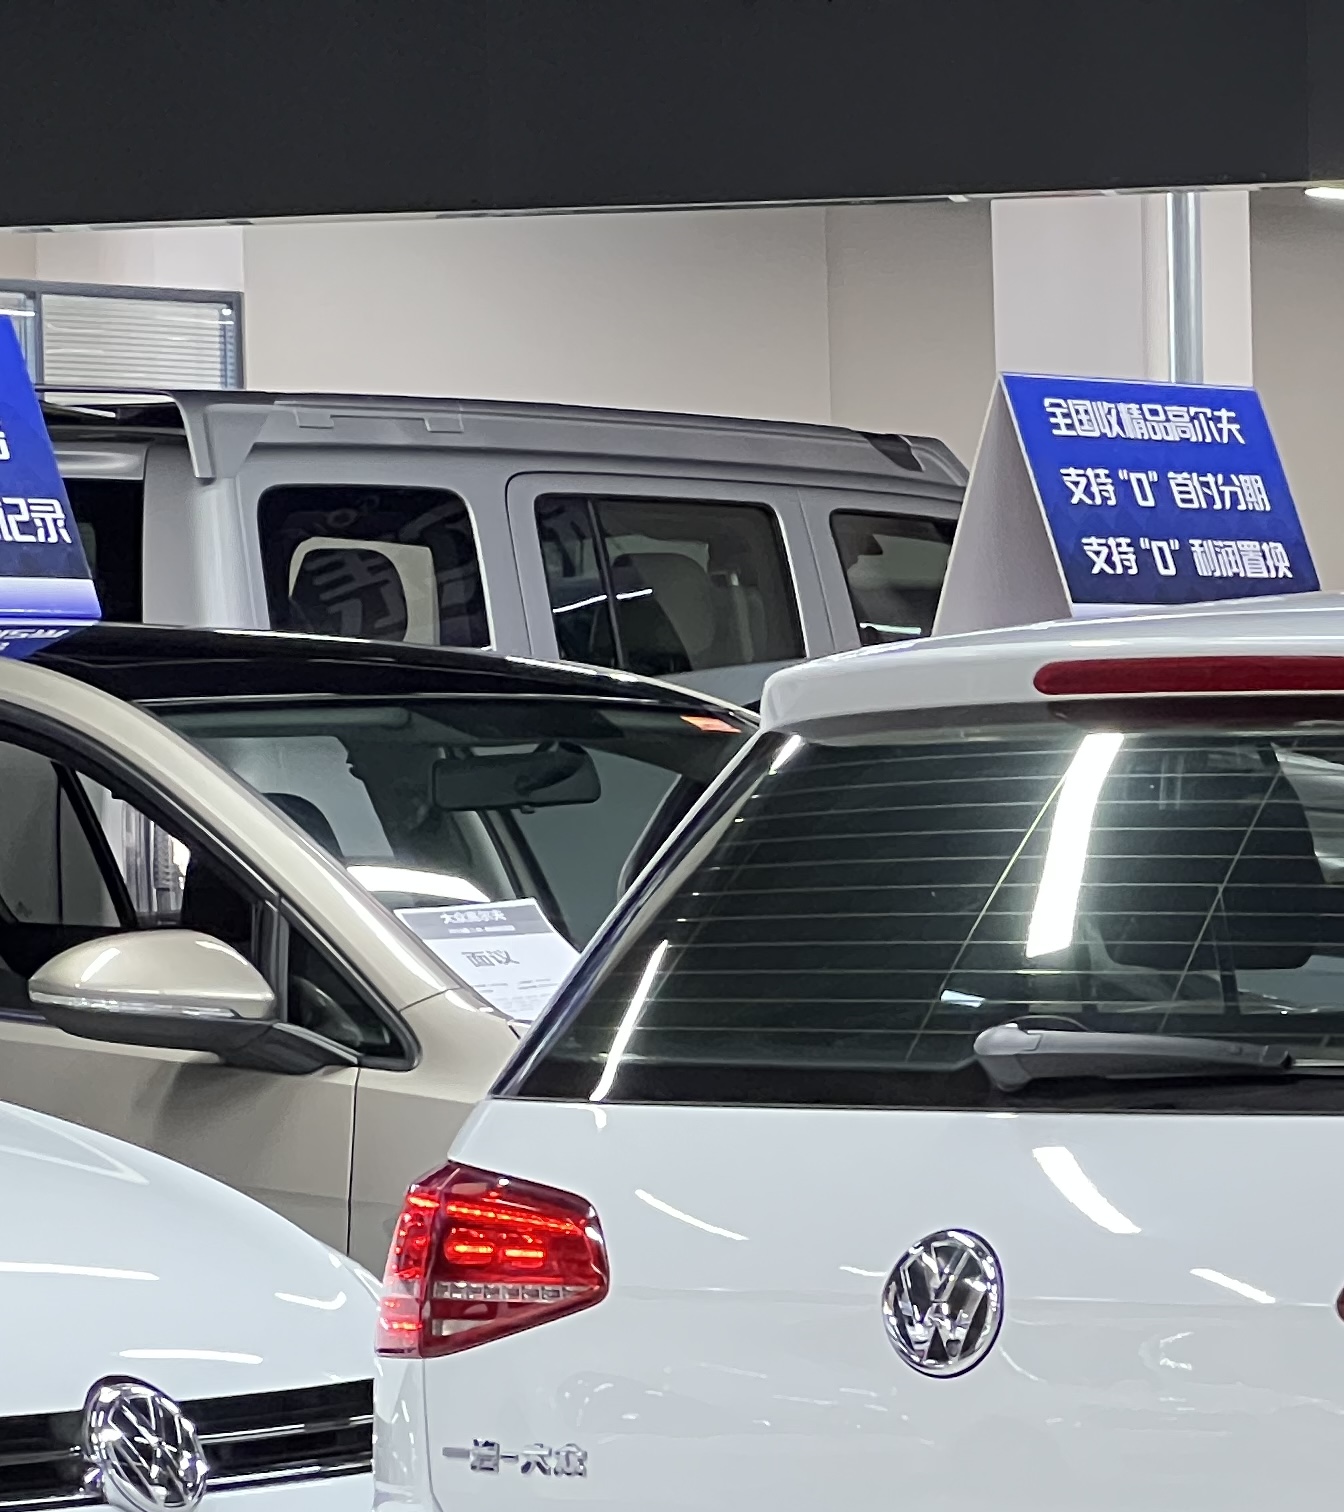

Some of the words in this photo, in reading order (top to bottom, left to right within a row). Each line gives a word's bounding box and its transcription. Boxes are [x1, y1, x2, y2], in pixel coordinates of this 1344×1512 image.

[1044, 398, 1246, 445] 全国收精品高尔夫
